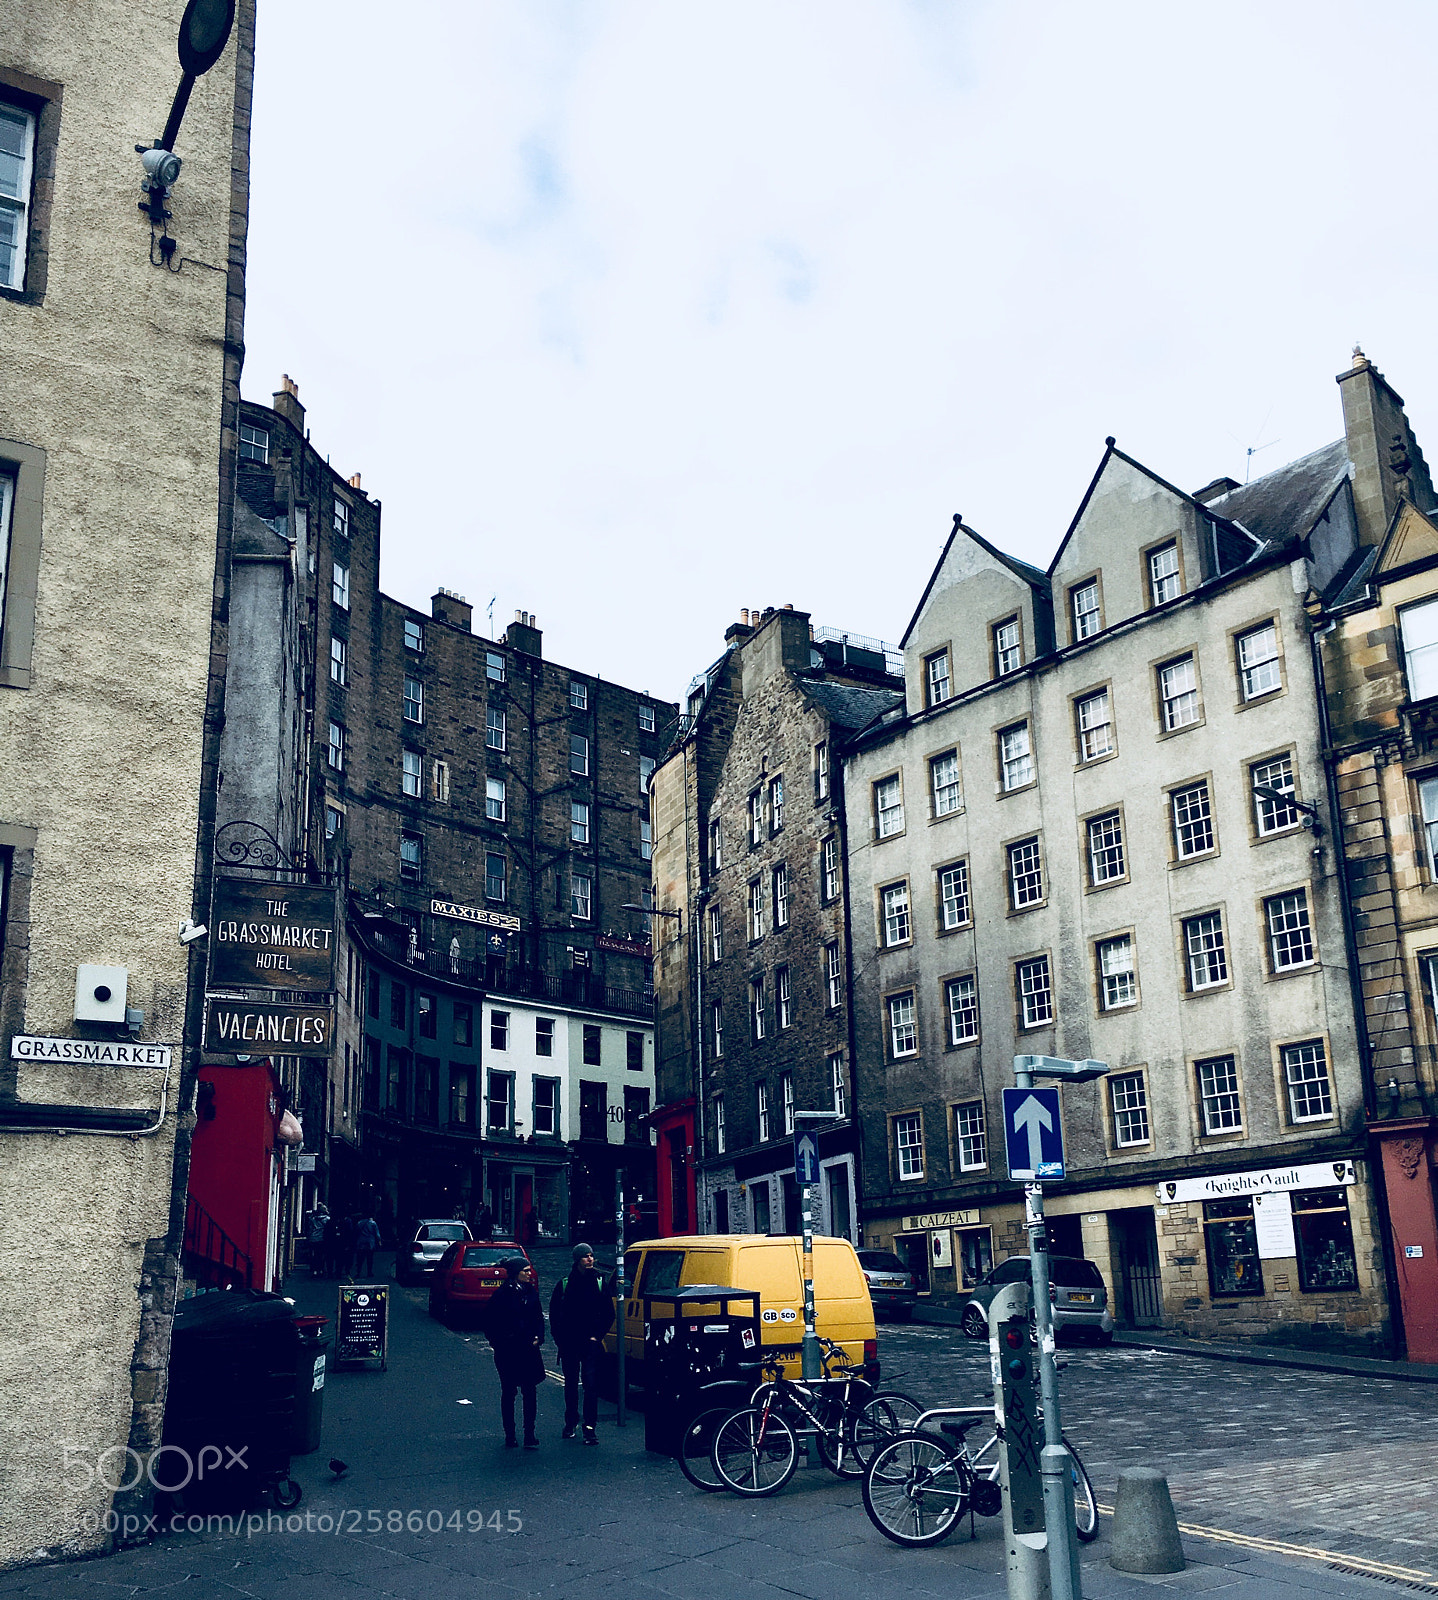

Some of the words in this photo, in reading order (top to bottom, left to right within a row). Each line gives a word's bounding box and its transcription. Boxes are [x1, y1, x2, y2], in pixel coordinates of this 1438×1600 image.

[266, 900, 289, 917] THE
[435, 902, 500, 924] MAXIES
[218, 920, 333, 949] GRASSMARKET
[256, 953, 293, 971] HOTEL
[218, 1012, 325, 1044] VACANCIES
[17, 1040, 166, 1064] GRASSMARKET
[607, 1105, 623, 1124] 40
[1205, 1176, 1258, 1193] Knights
[1260, 1170, 1300, 1186] Vault
[920, 1211, 971, 1227] CALZEAT
[763, 1312, 777, 1321] GB
